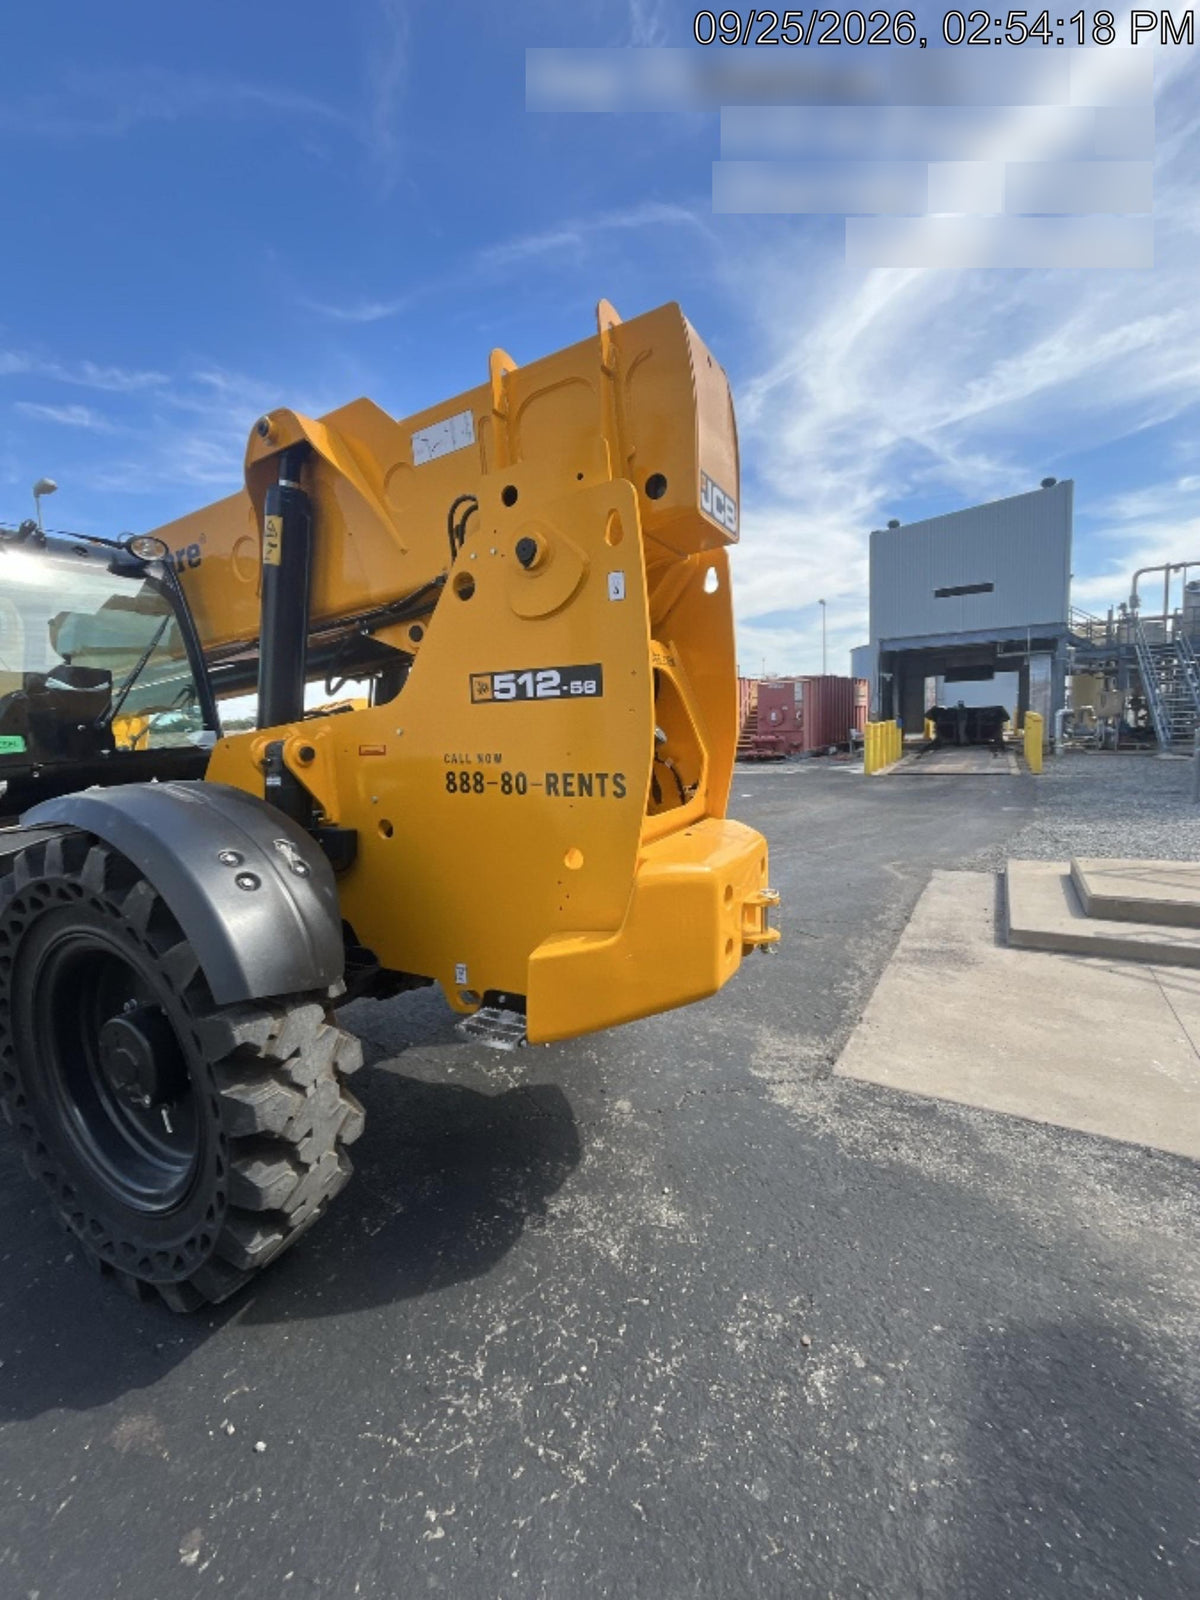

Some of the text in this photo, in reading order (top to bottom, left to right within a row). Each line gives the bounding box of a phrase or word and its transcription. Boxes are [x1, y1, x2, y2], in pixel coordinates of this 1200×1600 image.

[701, 478, 736, 535] JCB
[443, 752, 503, 764] CALL NOW
[445, 770, 627, 800] 888-80-RENTS
